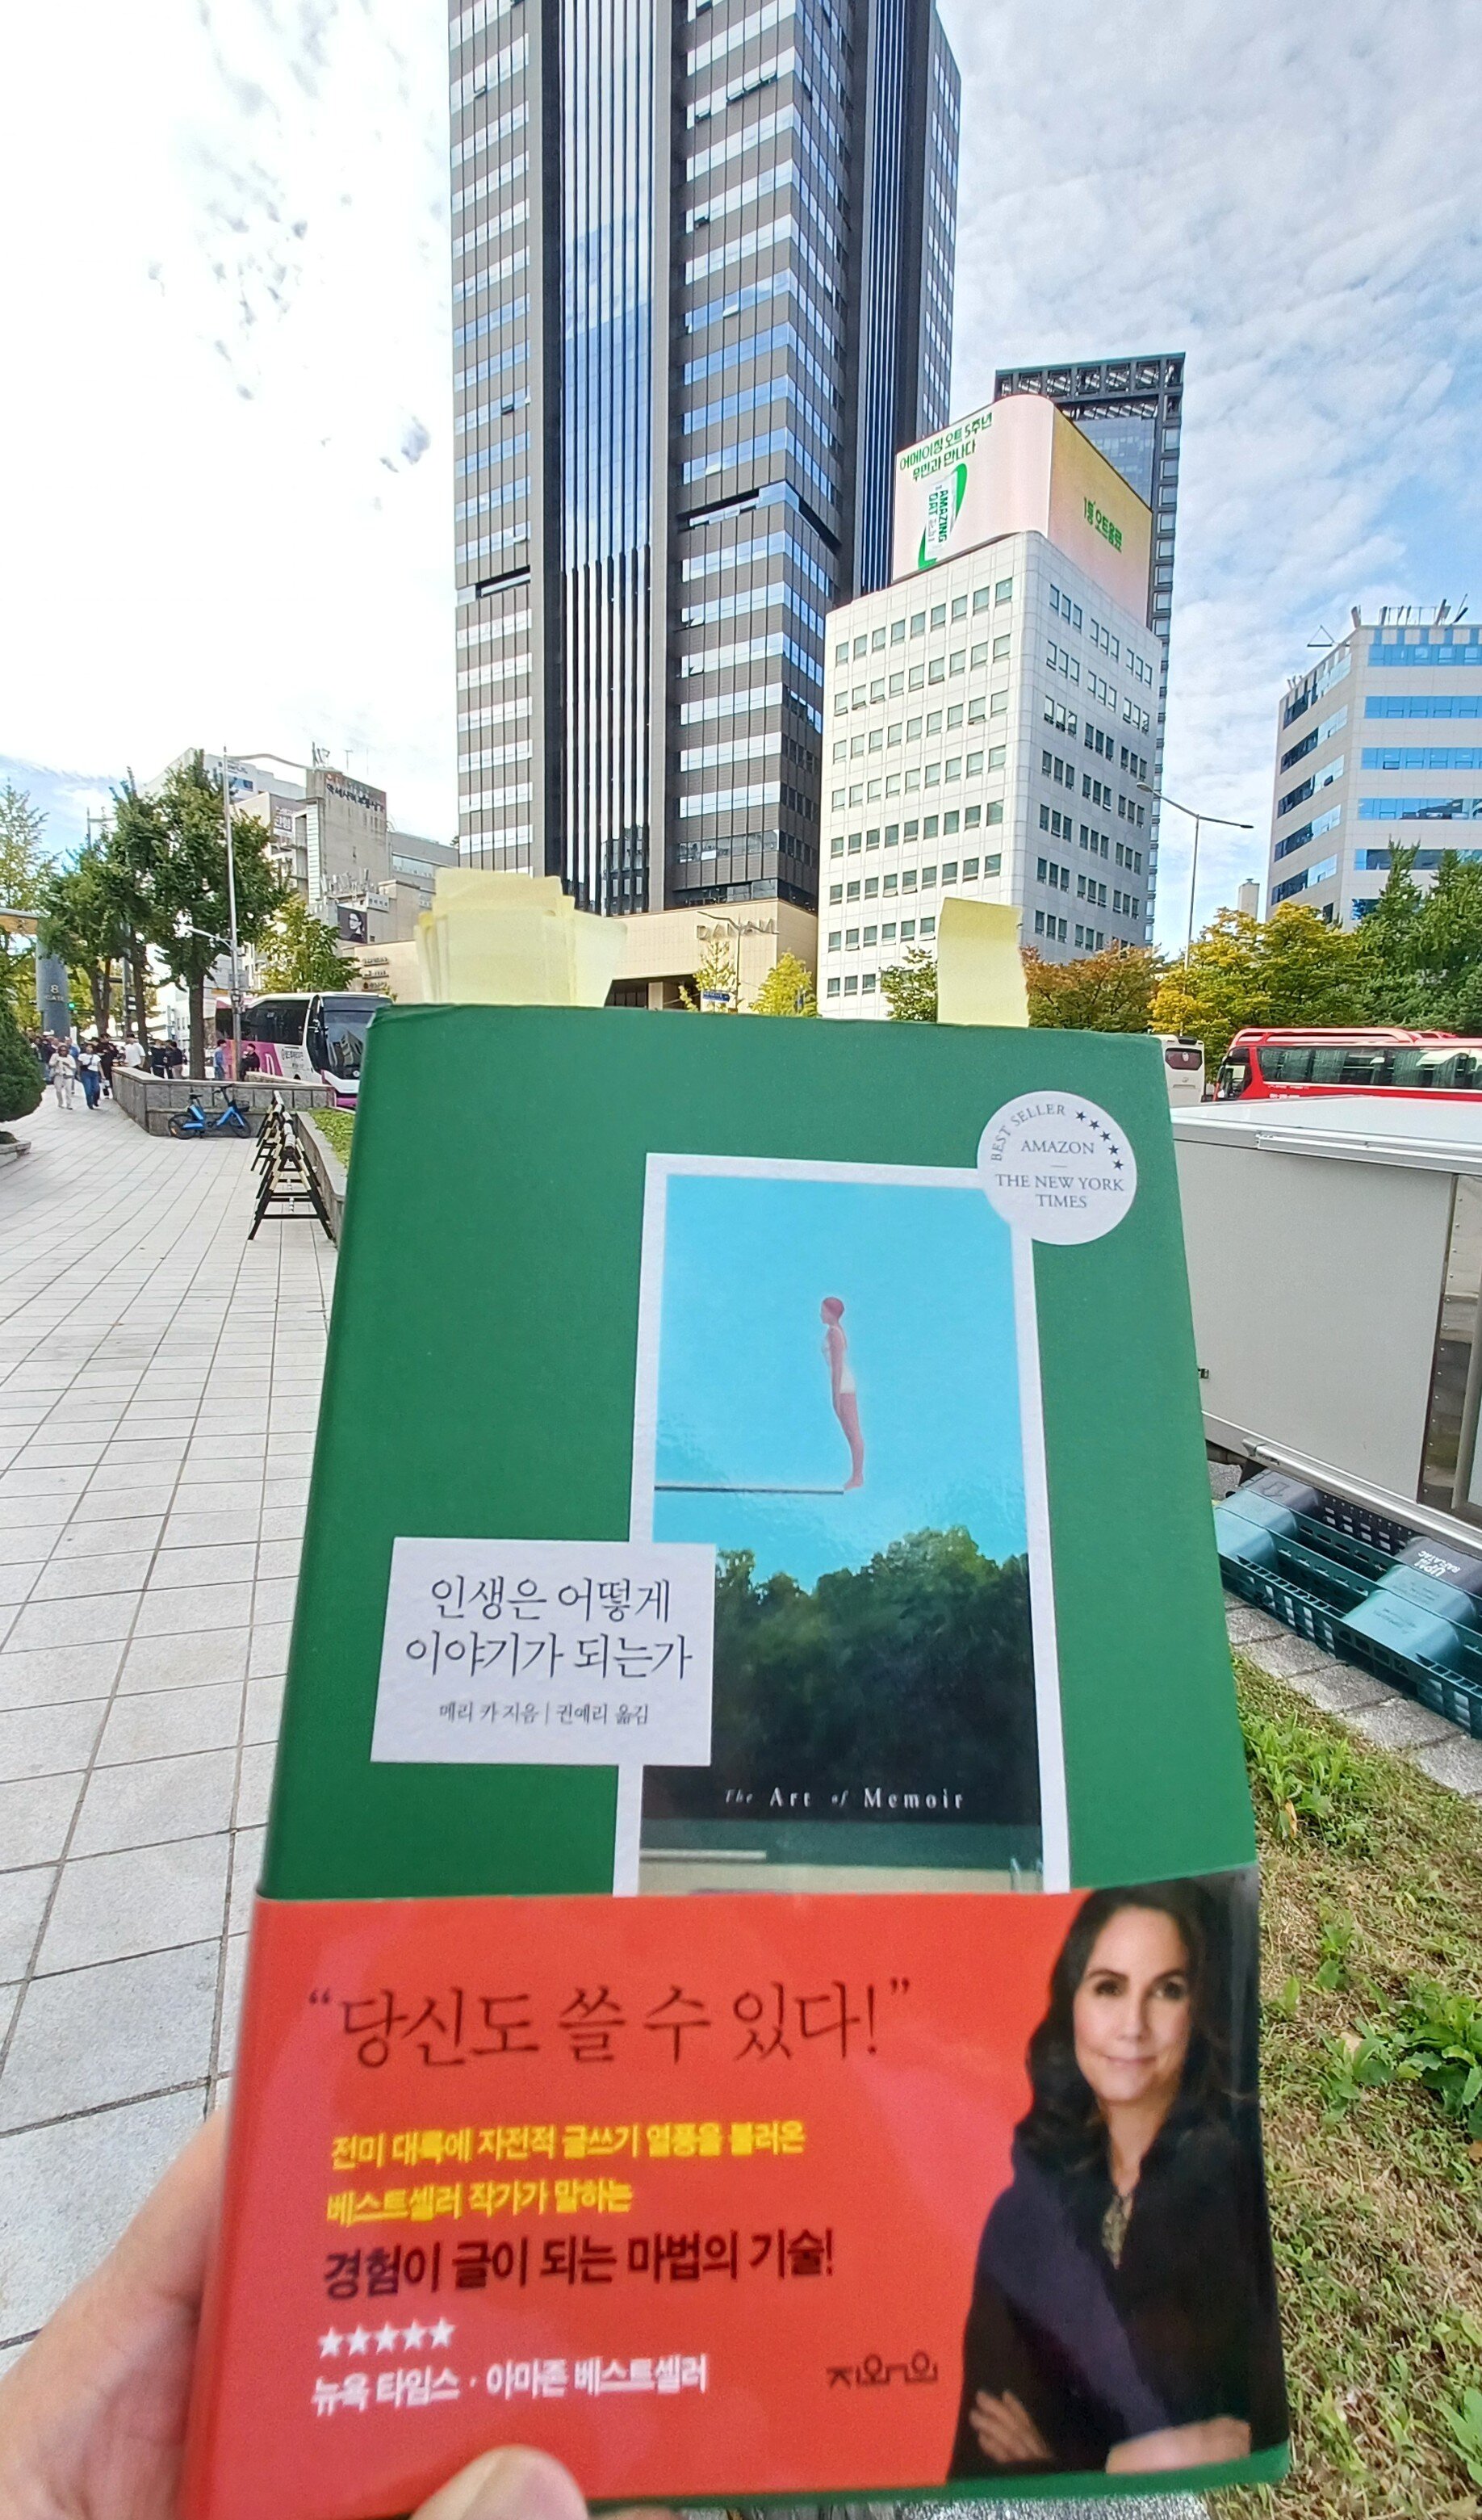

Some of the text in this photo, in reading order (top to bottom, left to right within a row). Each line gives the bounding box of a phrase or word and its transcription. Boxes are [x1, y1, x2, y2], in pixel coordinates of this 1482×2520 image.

[899, 412, 993, 471] 어메이징 오트 5주년
[944, 438, 977, 468] 만나다
[928, 492, 939, 515] OAT
[938, 489, 948, 543] AMAZING
[50, 984, 59, 994] 8
[990, 1104, 1066, 1162] BEST SELLER
[1020, 1139, 1095, 1155] AMAZON
[994, 1173, 1125, 1193] THE NEW YORK
[1035, 1193, 1088, 1210] TIMES
[431, 1574, 671, 1623] 인생은 어떻게
[406, 1629, 693, 1680] 이야기가 되는가
[439, 1700, 474, 1725] 메리
[502, 1701, 539, 1726] 지음
[556, 1703, 608, 1725] 권예리
[615, 1703, 649, 1726] 옮김
[726, 1786, 964, 1809] The Art of Memoir
[308, 1977, 911, 2069] “당신도 쓸 수 있다!”
[332, 2131, 386, 2171] 전미
[391, 2126, 475, 2166] 대륙에
[478, 2124, 558, 2162] 자전적
[563, 2121, 640, 2160] 글쓰기
[730, 2120, 806, 2157] 불러온
[326, 2177, 634, 2229] 베스트셀러 작가가 말하는
[324, 2227, 834, 2300] 경험이 글이 되는 마법의 기술!
[311, 2353, 709, 2417] 뉴욕 타임스 아마존 베스트셀러
